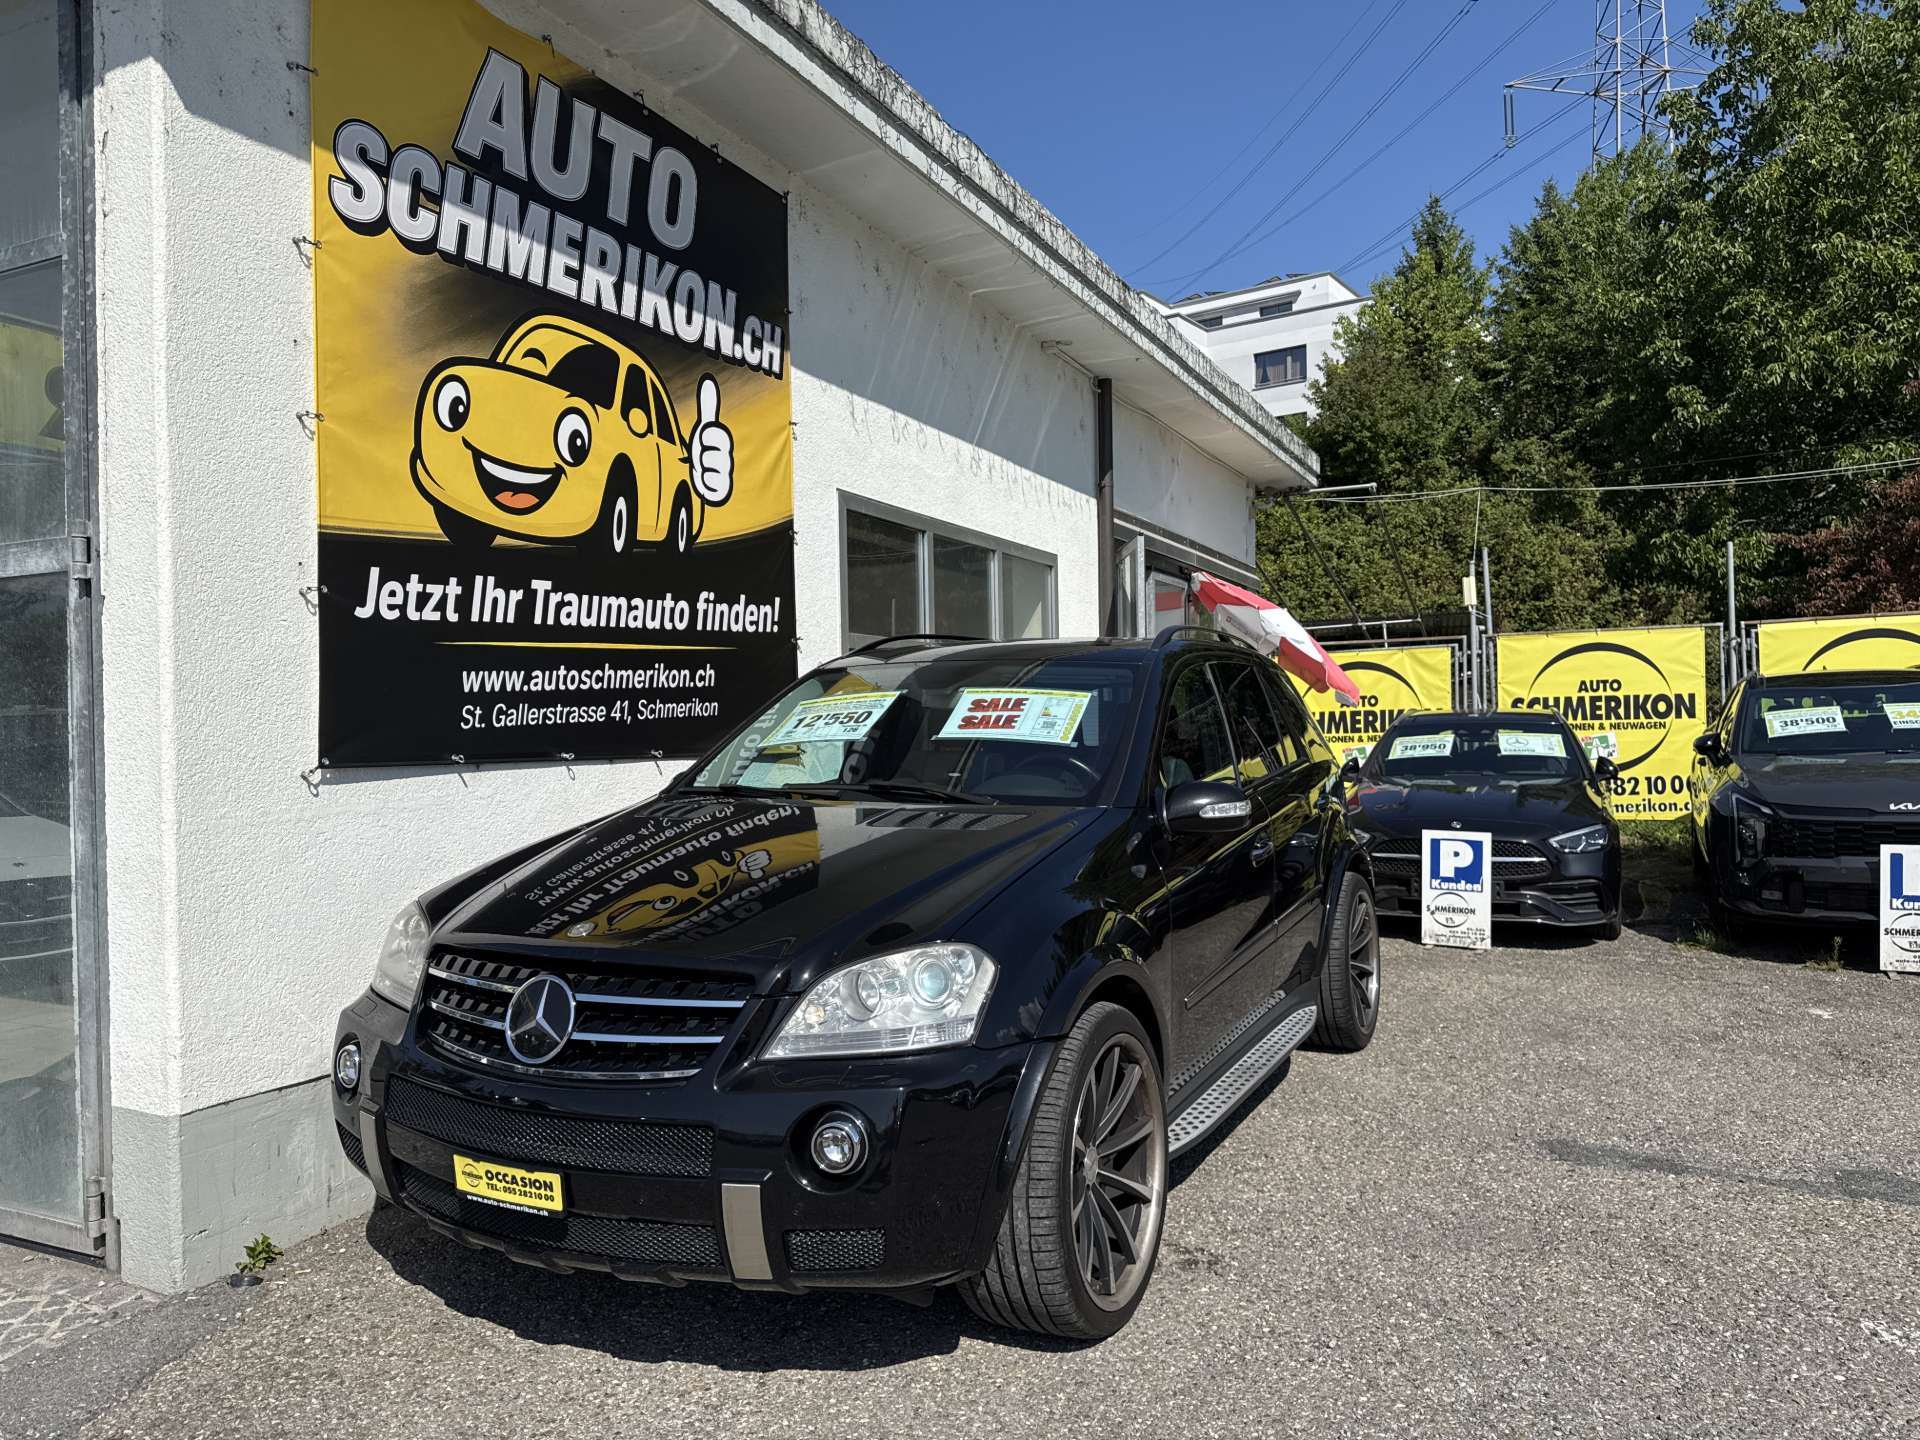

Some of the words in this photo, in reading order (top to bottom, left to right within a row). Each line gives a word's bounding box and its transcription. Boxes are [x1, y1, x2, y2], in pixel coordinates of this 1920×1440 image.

[453, 48, 698, 250] AUTO
[330, 119, 784, 378] SCHMERIKON.CH
[354, 566, 461, 622] Jetzt
[471, 575, 523, 625] Ihr
[531, 580, 689, 631] Traumauto
[697, 591, 779, 633] finden!
[462, 664, 715, 693] www.autoschmerikon.ch
[1578, 679, 1622, 693] AUTO
[460, 704, 485, 729] St.
[492, 701, 606, 727] Gallerstrasse
[611, 700, 631, 726] 41,
[637, 697, 718, 720] Schmerikon
[968, 697, 1030, 712] SALE
[792, 711, 873, 729] 12'550
[958, 715, 1021, 730] SALE
[1598, 722, 1605, 730] &
[1610, 722, 1667, 730] NEUWAGEN
[1779, 716, 1837, 728] 38'500
[1645, 775, 1666, 795] 10
[1440, 840, 1474, 878] P
[1431, 879, 1482, 891] Kunden
[1427, 904, 1476, 915] SHMERIKON
[485, 1169, 554, 1193] OCCASION
[486, 1182, 501, 1192] TEL:
[467, 1194, 549, 1217] www.auto-schmerikon.ch
